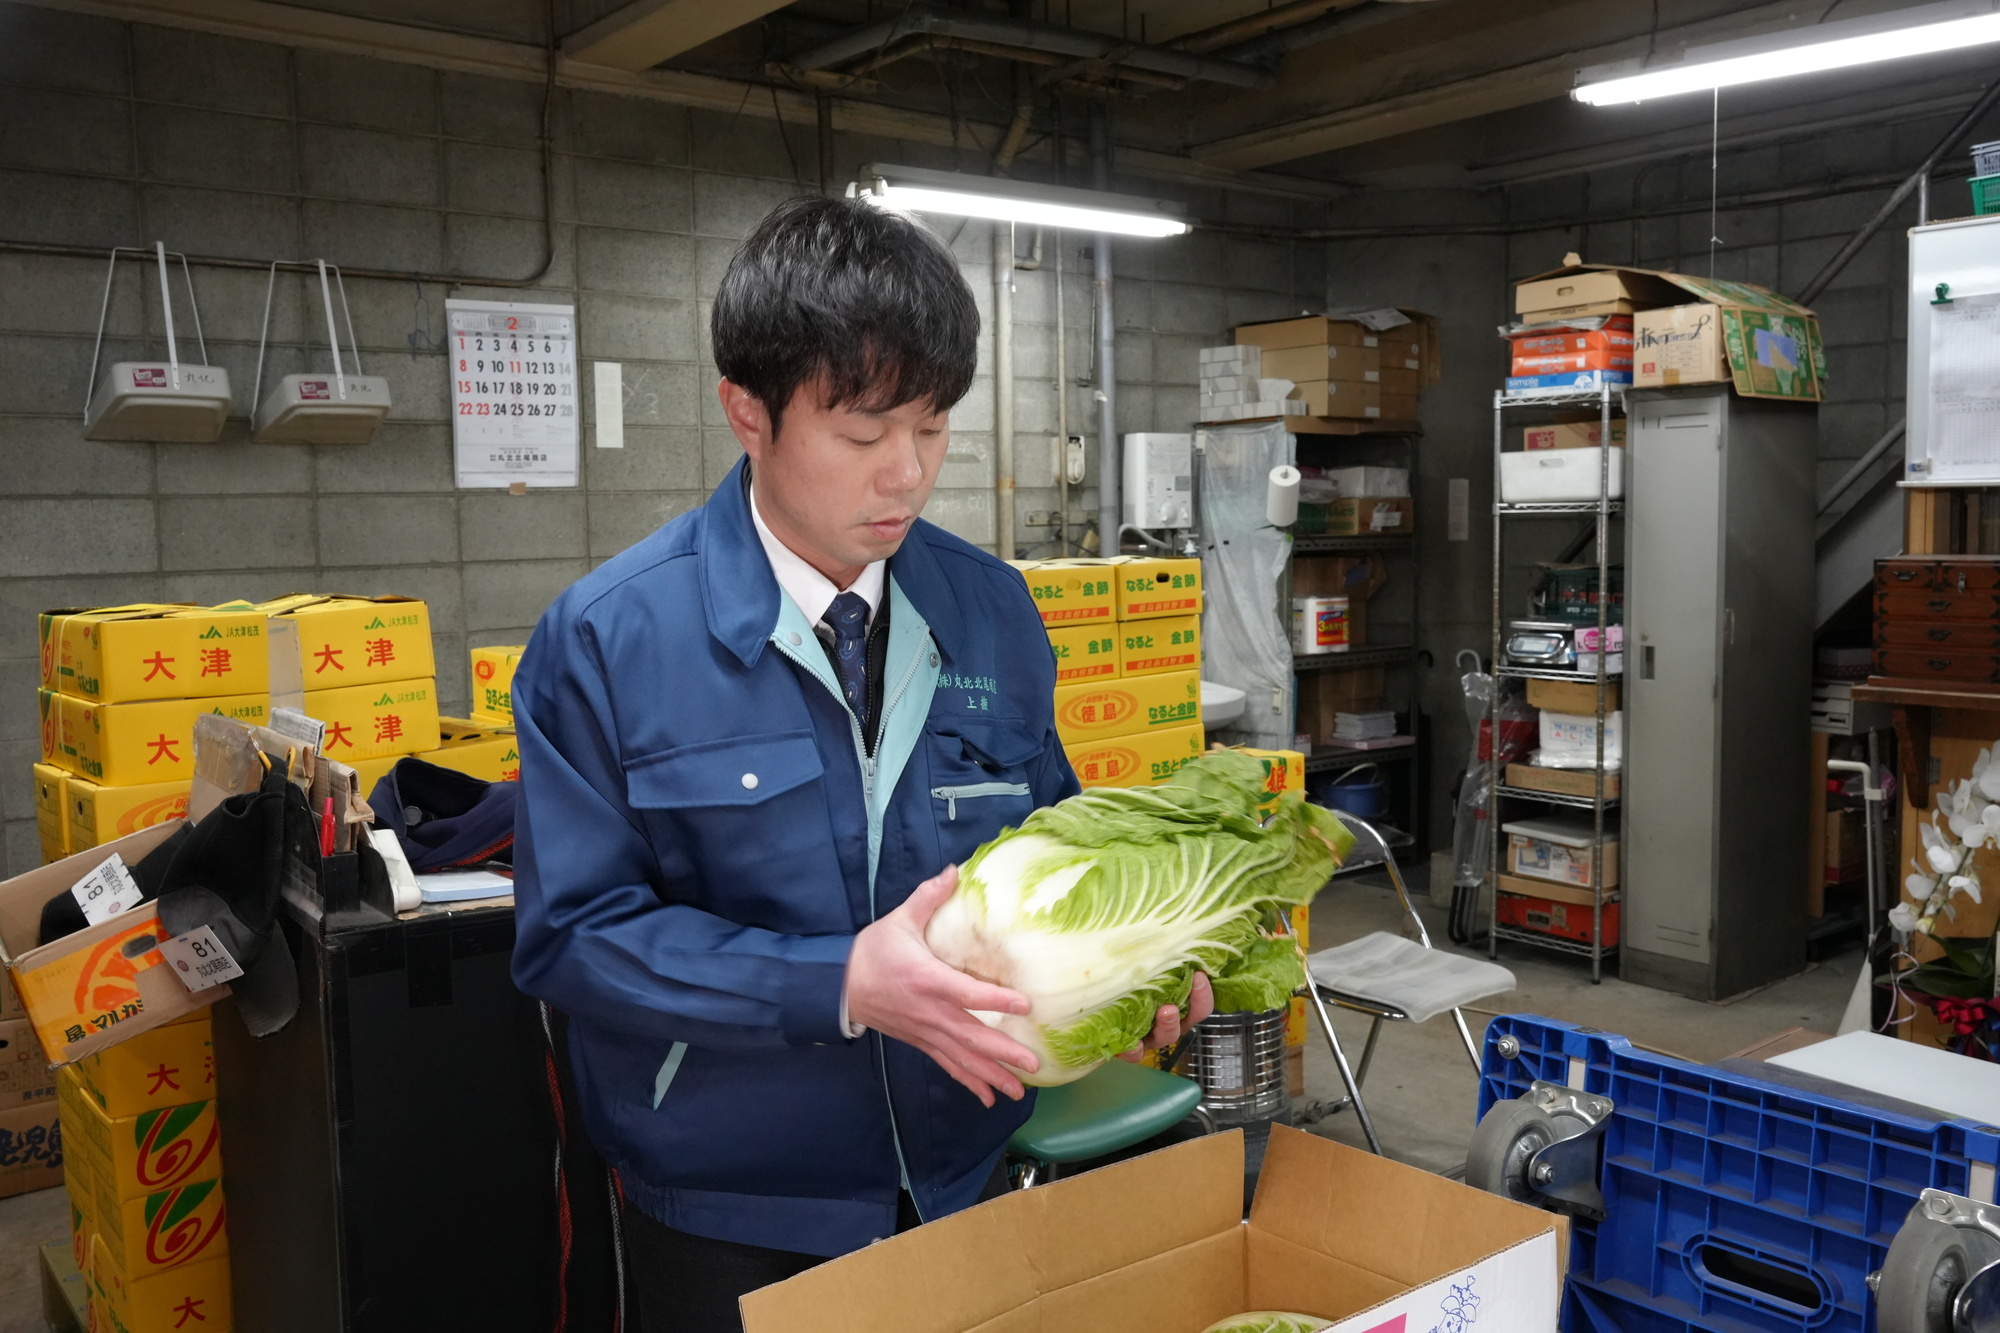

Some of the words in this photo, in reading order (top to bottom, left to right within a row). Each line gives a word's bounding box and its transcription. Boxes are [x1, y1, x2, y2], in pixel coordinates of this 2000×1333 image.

[507, 317, 518, 330] 2
[459, 338, 464, 350] 1
[476, 339, 483, 351] 2
[494, 339, 500, 351] 3
[511, 340, 517, 352] 4
[528, 341, 534, 353] 5
[545, 341, 551, 353] 6
[561, 342, 567, 354] 7
[459, 360, 467, 372] 8
[477, 360, 484, 372] 9
[492, 361, 504, 373] 10
[510, 362, 521, 374] 11
[526, 362, 538, 374] 12
[543, 362, 555, 375] 13
[559, 363, 571, 375] 14
[458, 381, 471, 393] 15
[476, 381, 488, 394] 16
[493, 382, 505, 394] 17
[510, 382, 522, 395] 18
[527, 383, 539, 395] 19
[544, 383, 556, 395] 20
[561, 384, 571, 396] 21
[459, 403, 472, 415] 22
[476, 403, 490, 415] 23
[494, 403, 507, 416] 24
[511, 404, 524, 416] 25
[528, 404, 540, 416] 26
[544, 404, 556, 417] 27
[560, 405, 573, 417] 28
[1033, 585, 1064, 600] なると
[1083, 581, 1109, 596] 金時
[1126, 578, 1154, 592] なると
[1172, 574, 1195, 588] 金時
[226, 625, 259, 638] JA大津松茂
[1125, 635, 1153, 650] なると
[1171, 630, 1194, 645] 金時
[313, 637, 395, 674] 大津
[1088, 638, 1113, 655] 金時
[143, 647, 232, 683] 大津
[937, 673, 997, 695] 株)丸北北尾商店
[1081, 702, 1117, 723] 徳島
[1148, 701, 1197, 720] なると金時
[324, 714, 403, 751] 大津
[146, 733, 181, 766] 大
[1084, 759, 1119, 781] 徳島
[83, 876, 103, 901] 81
[191, 937, 217, 958] 81
[173, 1296, 206, 1329] 大
